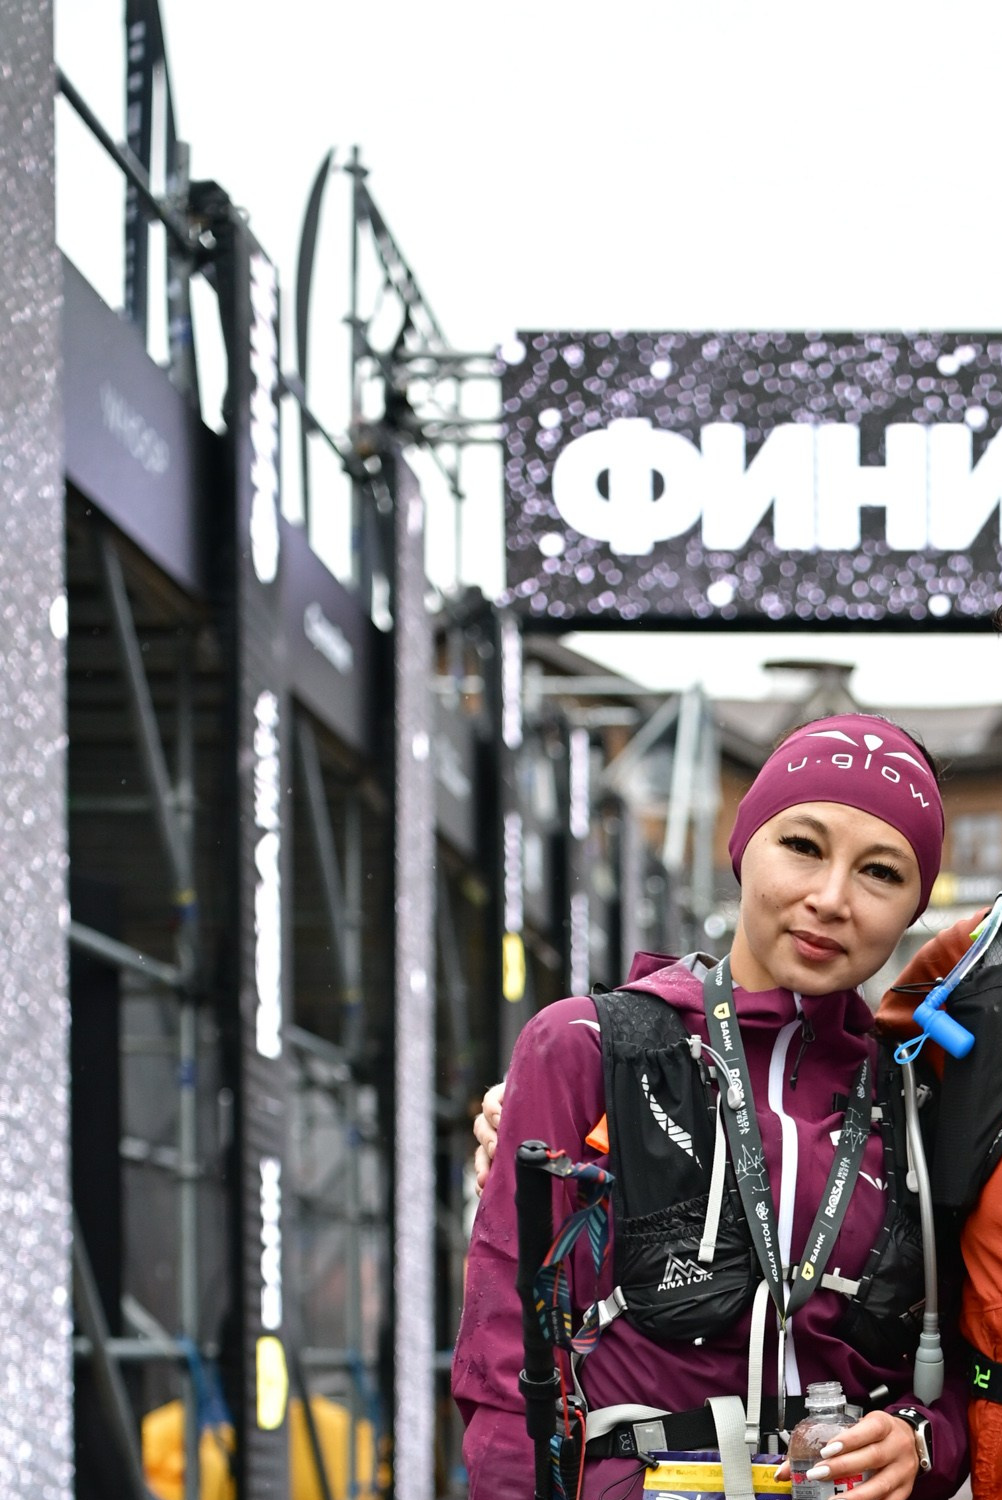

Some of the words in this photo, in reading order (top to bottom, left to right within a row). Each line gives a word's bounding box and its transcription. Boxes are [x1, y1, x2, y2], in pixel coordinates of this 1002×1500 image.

[720, 1020, 733, 1052] БАНК
[825, 1180, 846, 1218] ROSA
[761, 1223, 772, 1248] РОЗА
[767, 1251, 779, 1282] ХУТОР
[810, 1232, 826, 1263] БАНК
